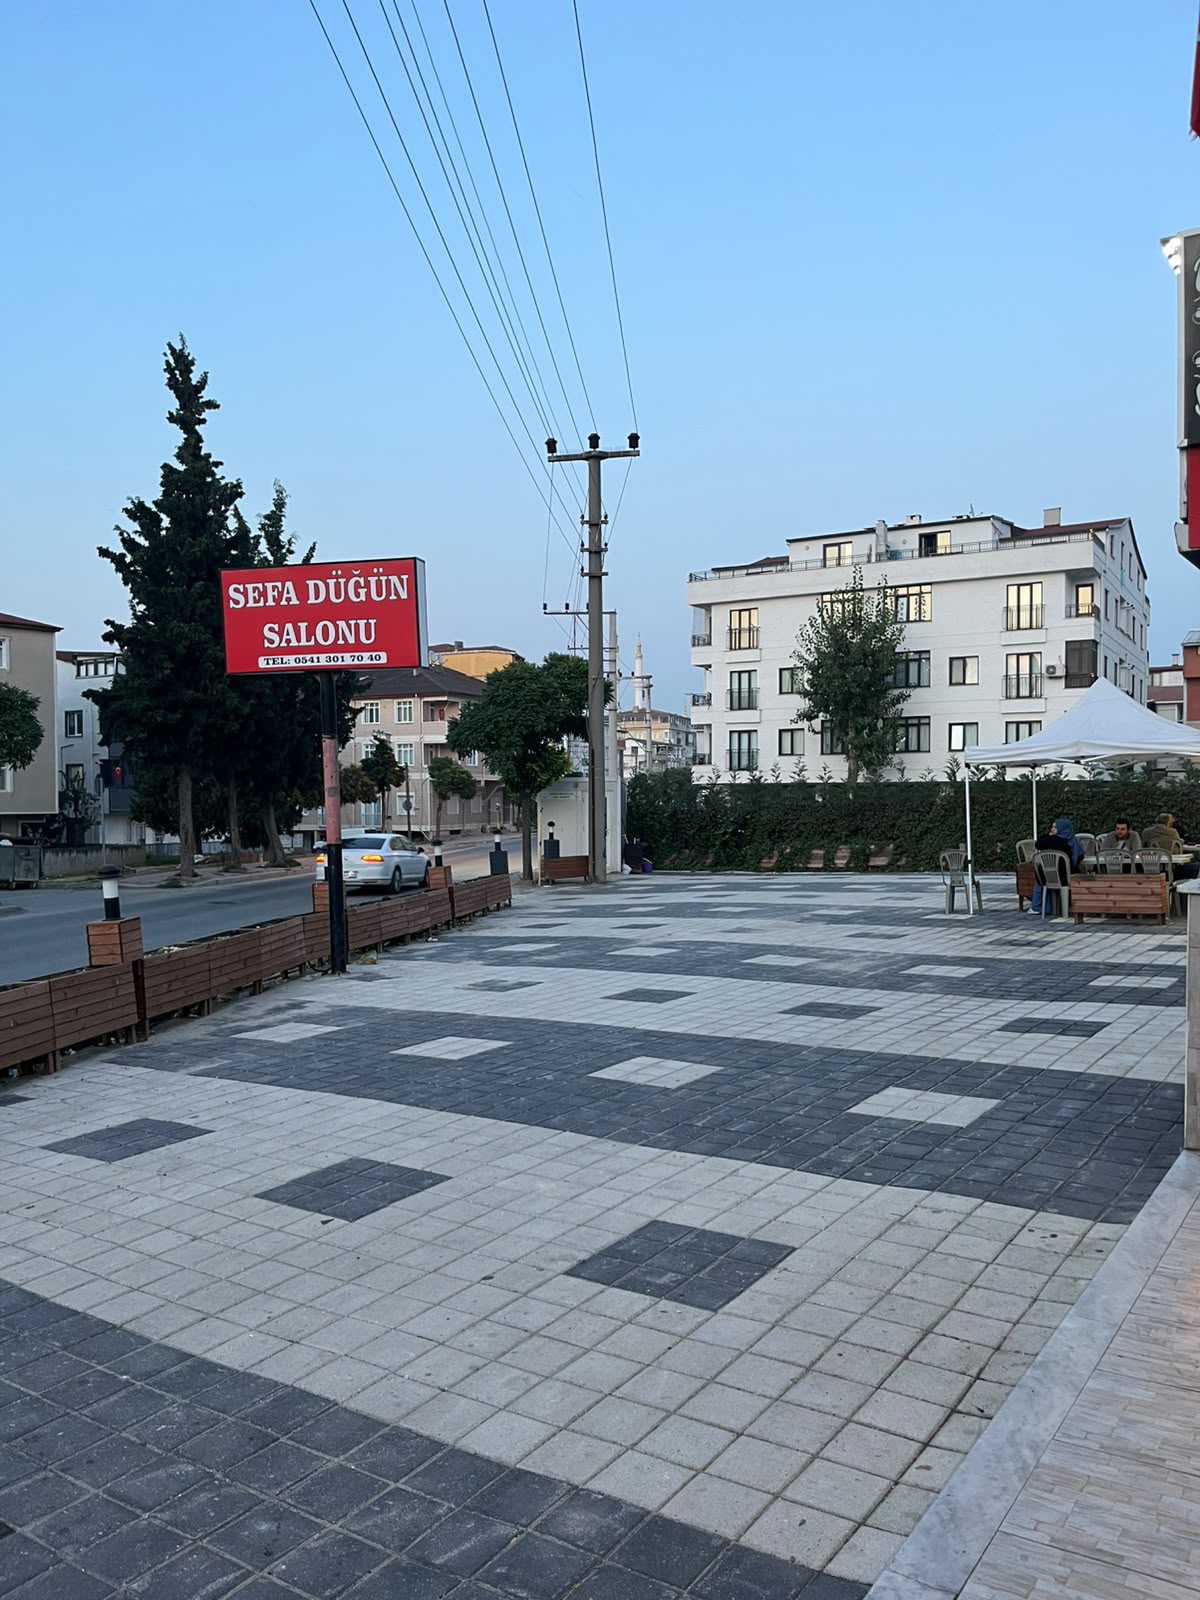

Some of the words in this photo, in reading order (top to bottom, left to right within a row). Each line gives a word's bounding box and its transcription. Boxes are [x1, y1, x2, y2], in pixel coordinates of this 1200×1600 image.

[228, 581, 300, 609] SEFA
[306, 567, 409, 604] DÜĞÜN
[263, 619, 377, 648] SALONU
[294, 656, 321, 665] 0541
[325, 655, 345, 664] 301
[350, 654, 364, 663] 70
[367, 653, 382, 662] 40
